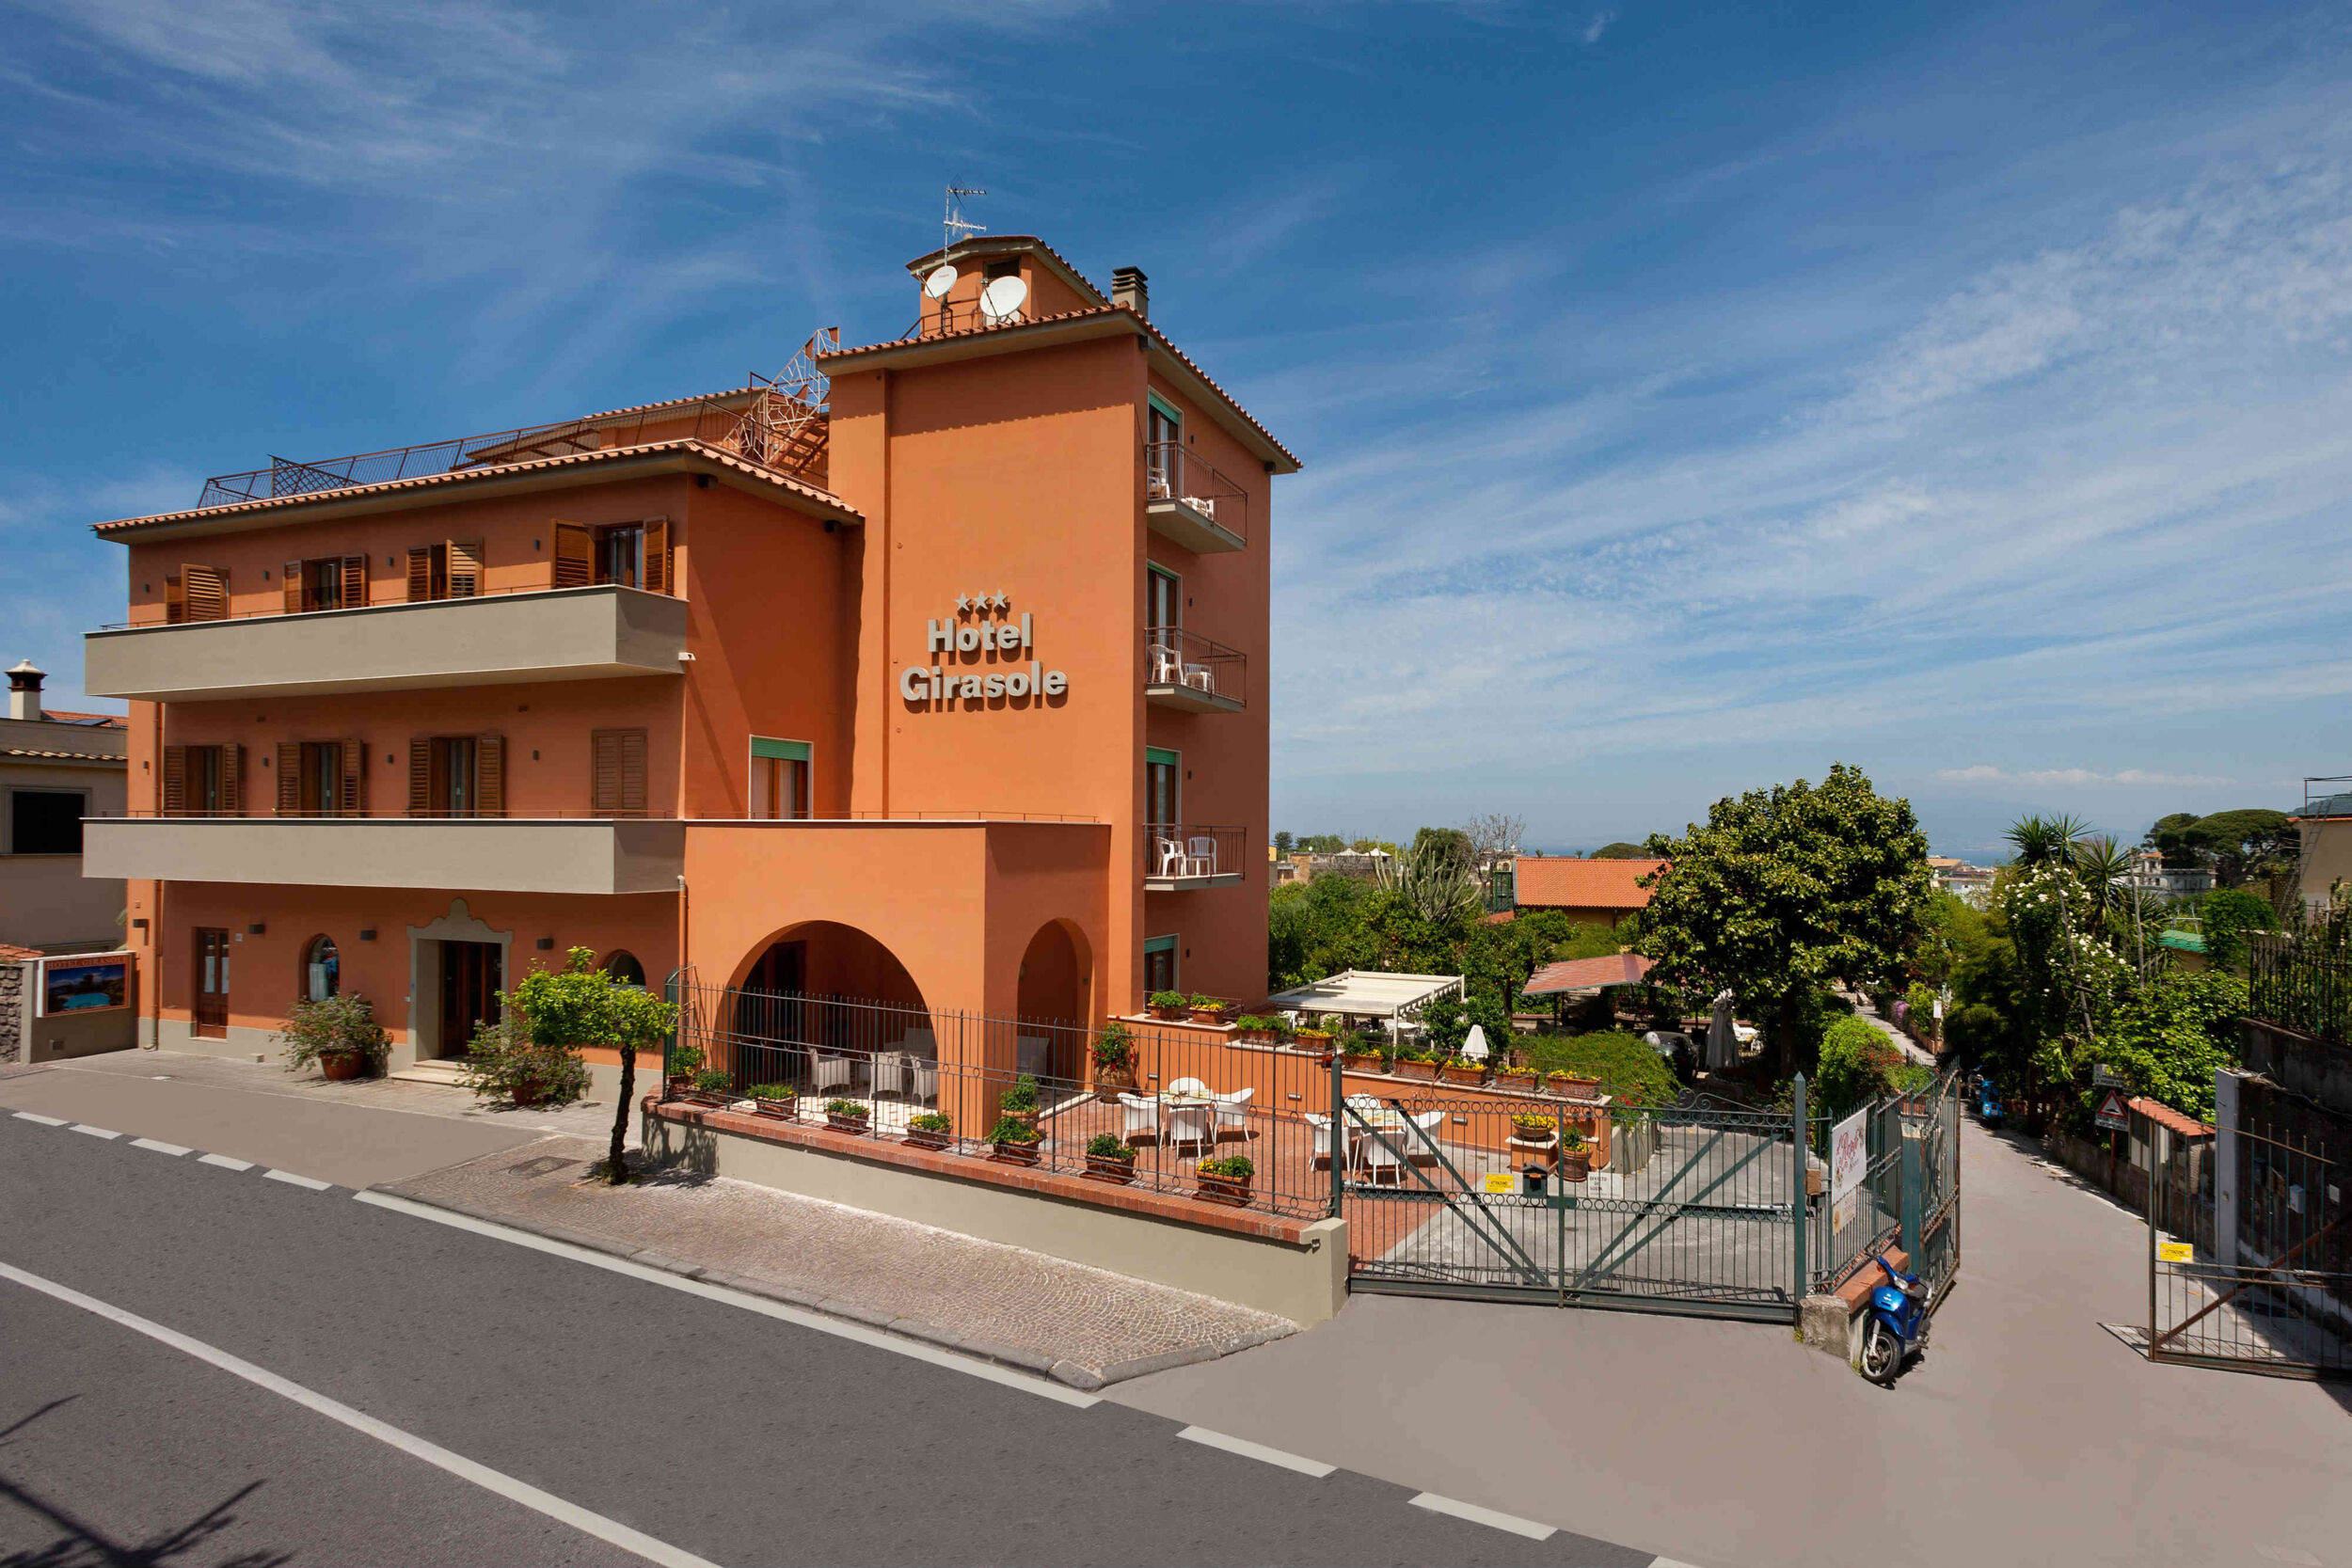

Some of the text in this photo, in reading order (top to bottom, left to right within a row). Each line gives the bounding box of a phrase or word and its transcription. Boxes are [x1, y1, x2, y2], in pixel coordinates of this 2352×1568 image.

[928, 612, 1033, 652] Hotel
[899, 660, 1068, 701] Girasole
[46, 956, 127, 969] HOTEL GIRASOLE
